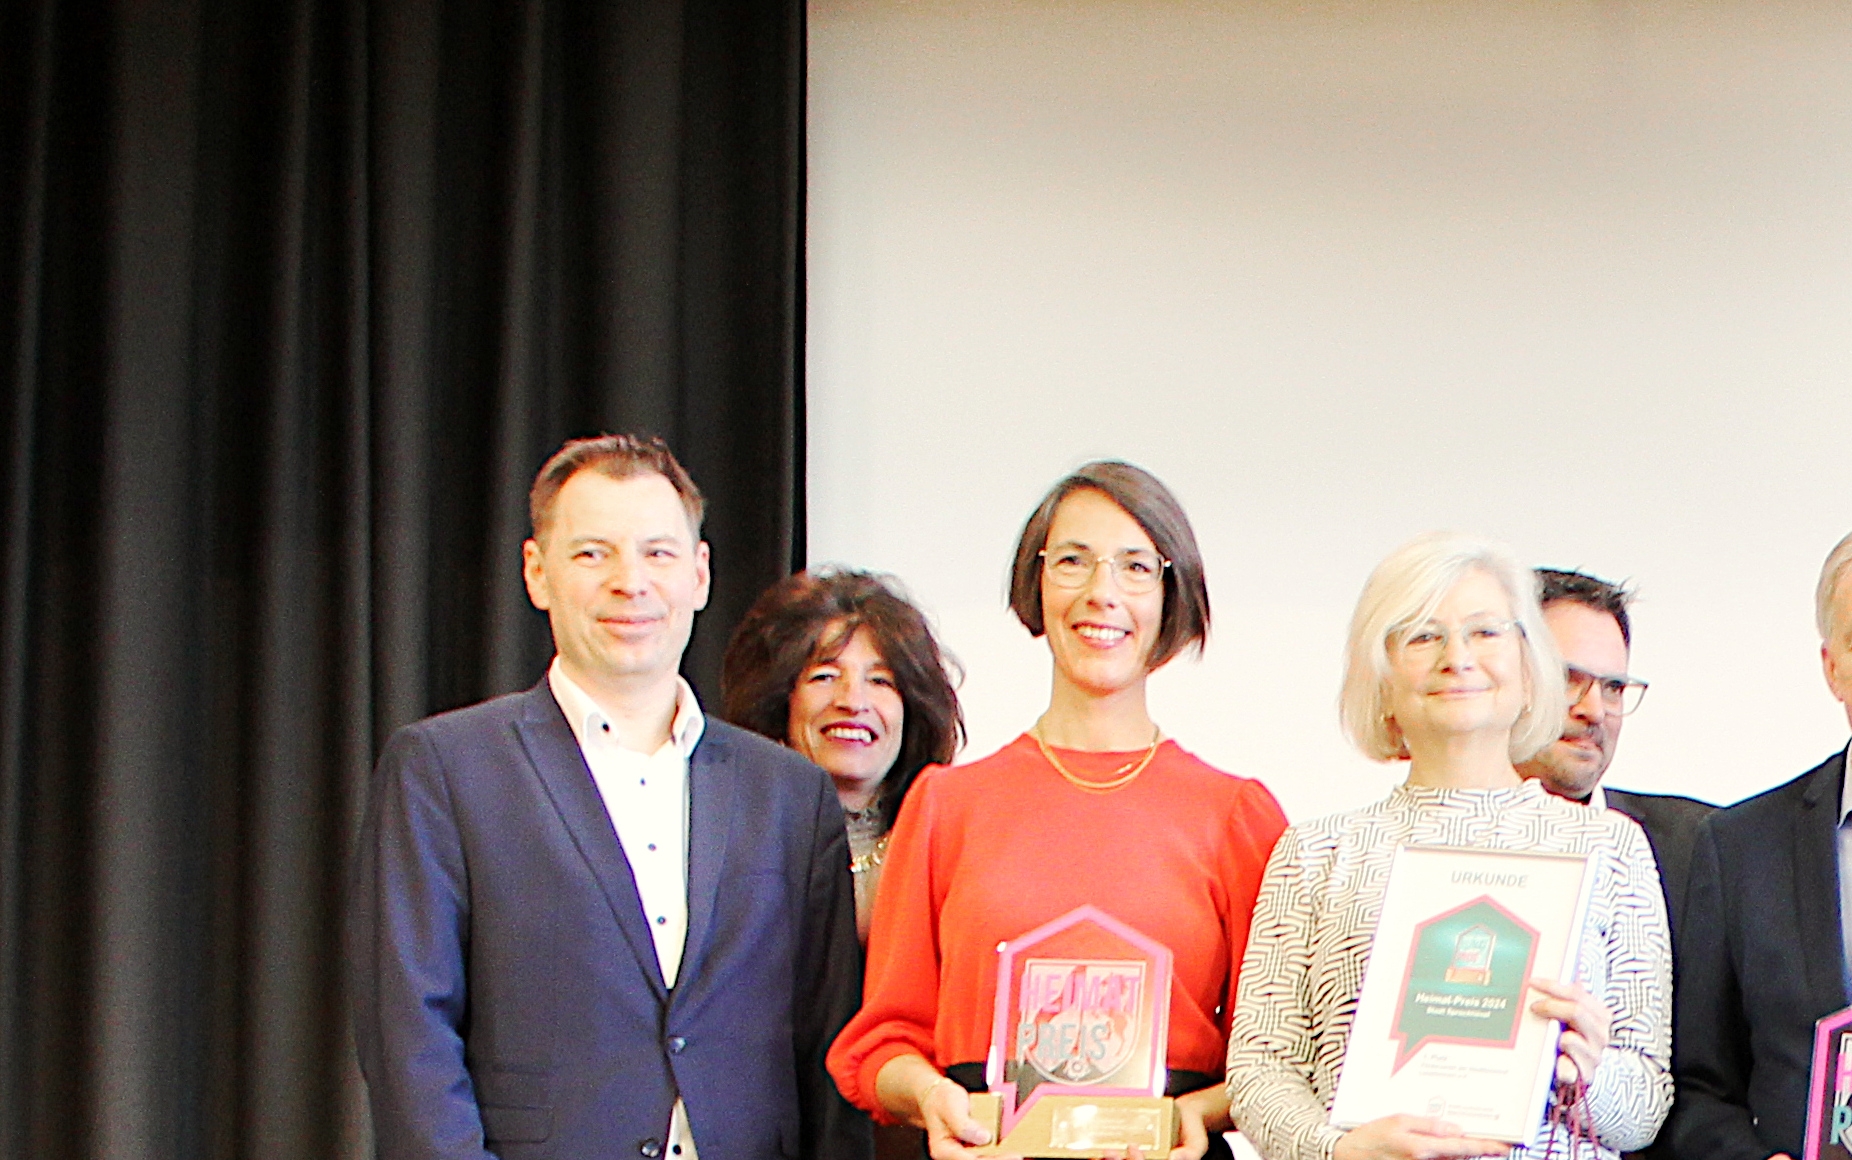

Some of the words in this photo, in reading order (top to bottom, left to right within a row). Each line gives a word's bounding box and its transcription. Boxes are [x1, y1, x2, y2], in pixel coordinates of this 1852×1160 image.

[1451, 870, 1529, 889] URKUNDE
[1020, 973, 1140, 1014] HEIMAT
[1481, 997, 1507, 1009] 2024
[1017, 1022, 1108, 1061] PREIS
